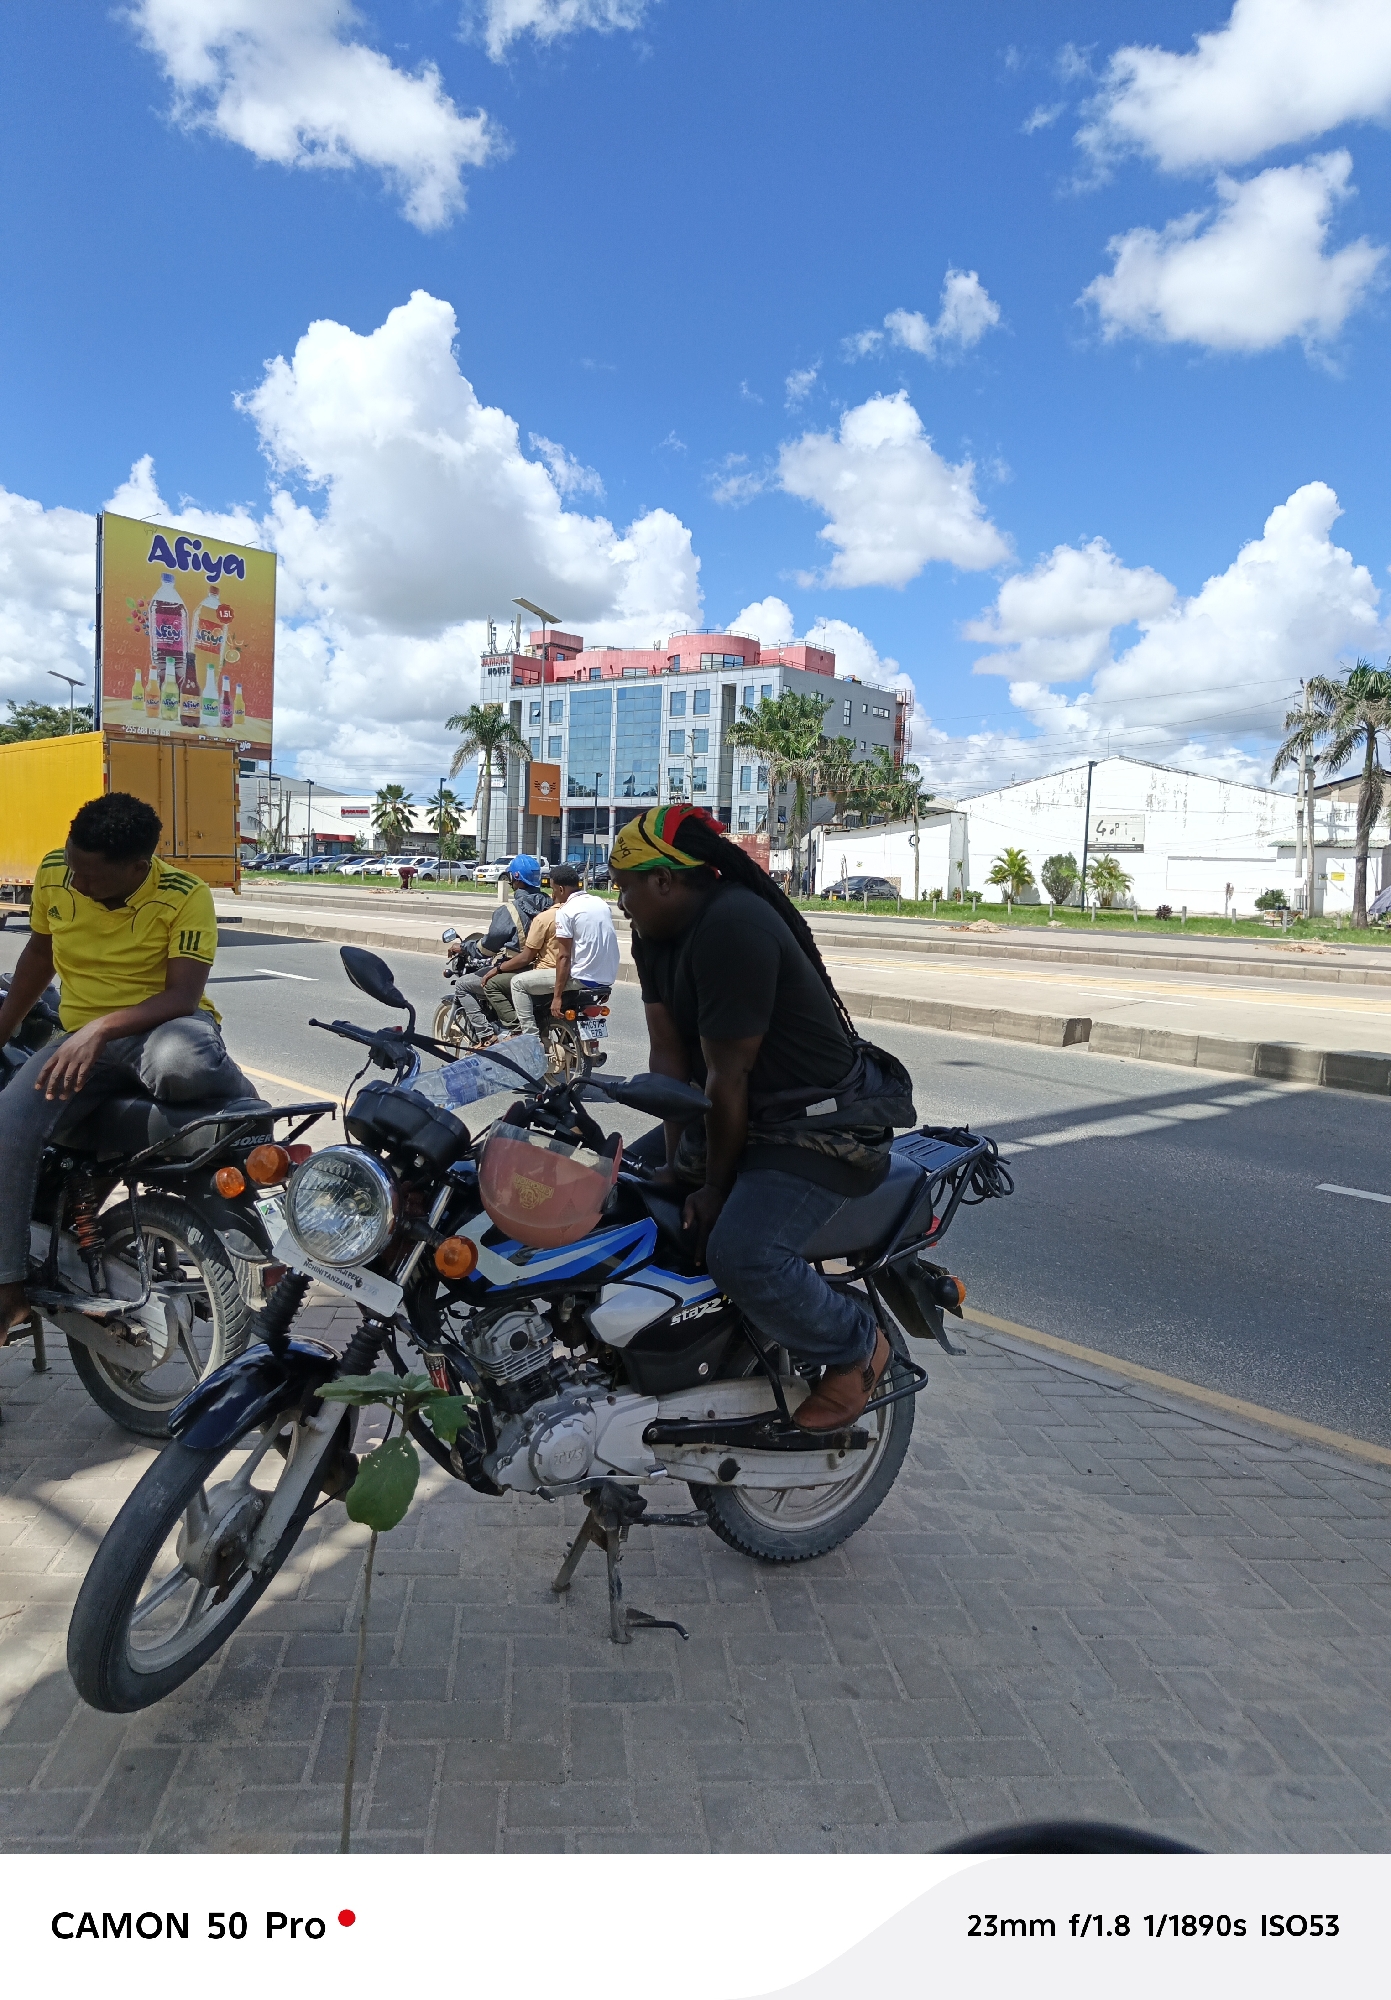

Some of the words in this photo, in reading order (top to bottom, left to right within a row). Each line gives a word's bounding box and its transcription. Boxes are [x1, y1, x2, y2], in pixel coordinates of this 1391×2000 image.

[147, 534, 246, 583] Afiya
[488, 667, 511, 677] HOUSE
[322, 1271, 353, 1292] TANZANIA
[553, 1448, 585, 1465] TVS
